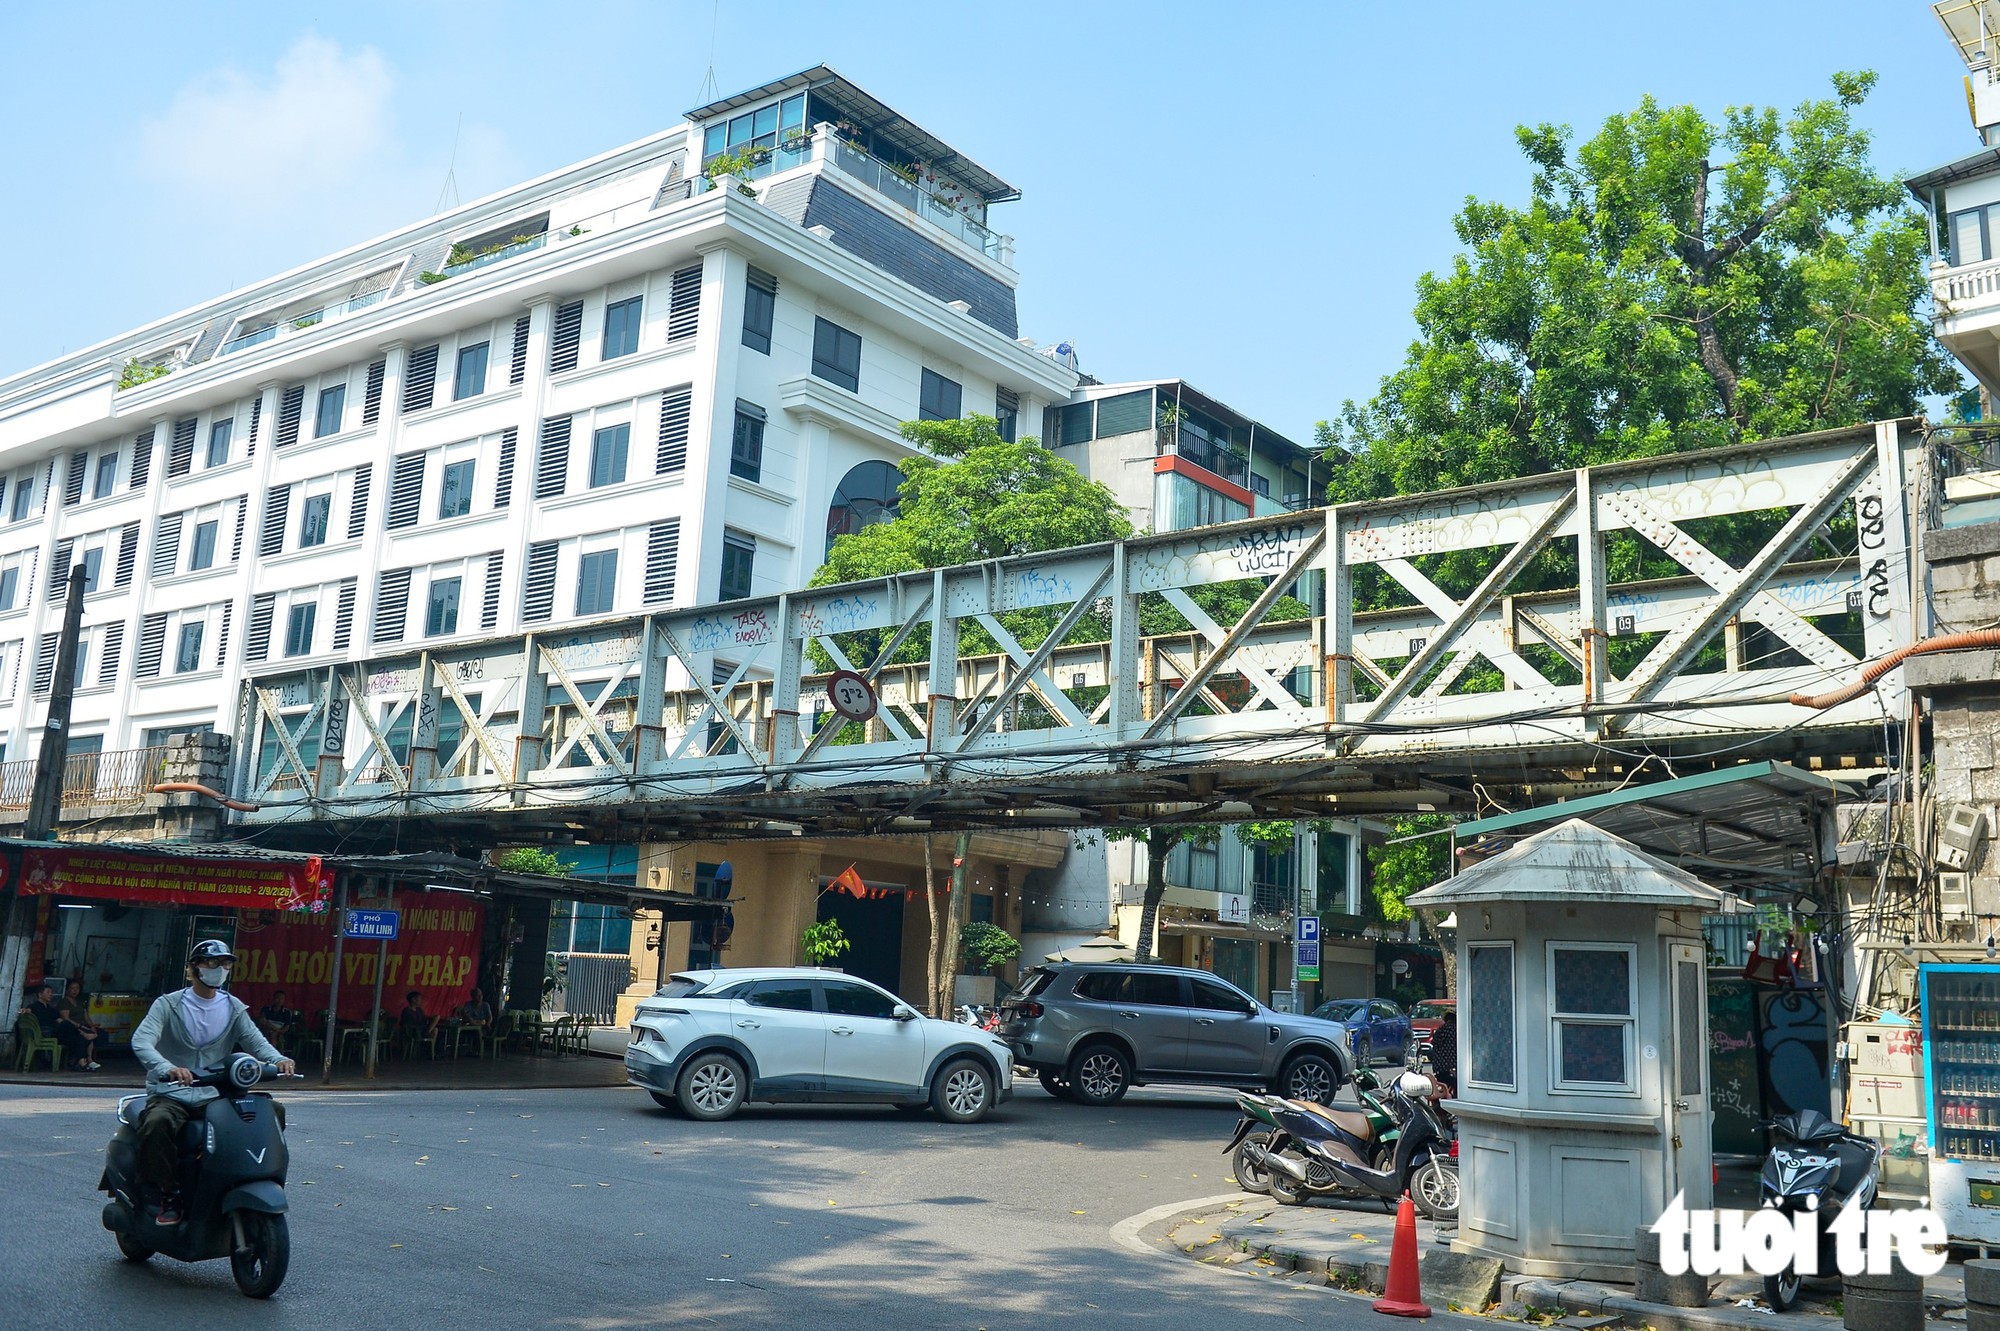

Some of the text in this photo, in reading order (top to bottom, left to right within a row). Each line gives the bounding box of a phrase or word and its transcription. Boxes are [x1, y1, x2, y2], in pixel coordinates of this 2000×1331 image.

[182, 880, 197, 893] VIỆT
[198, 883, 216, 893] NAM
[363, 913, 381, 922] PHỐ
[440, 906, 456, 931] HÀ
[457, 907, 477, 936] NỘI
[360, 922, 375, 934] VĂN
[376, 925, 393, 935] LINH
[1301, 920, 1316, 939] P
[232, 948, 280, 984] BIA
[406, 946, 472, 987] PHÁP
